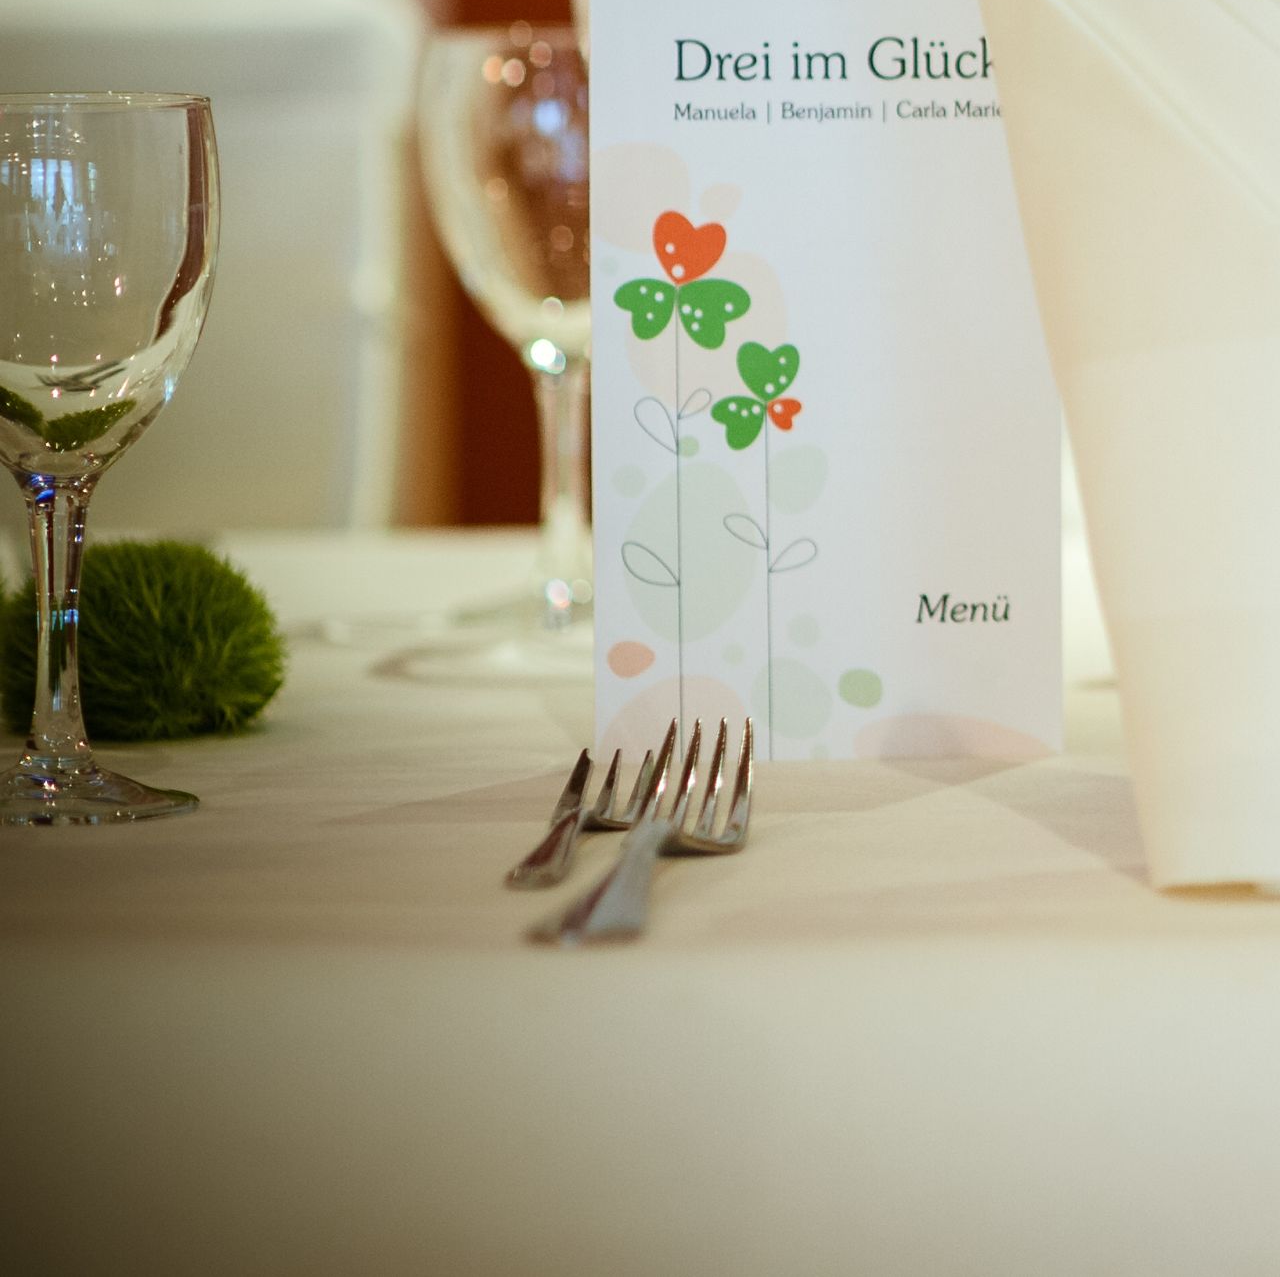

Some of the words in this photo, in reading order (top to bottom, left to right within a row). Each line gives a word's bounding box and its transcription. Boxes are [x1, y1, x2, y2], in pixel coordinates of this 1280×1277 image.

[674, 39, 772, 82] Drei
[792, 41, 848, 81] im
[674, 102, 756, 121] Manuela
[781, 101, 873, 123] Benjamin
[896, 100, 947, 119] Carla
[916, 593, 1010, 624] Menü
